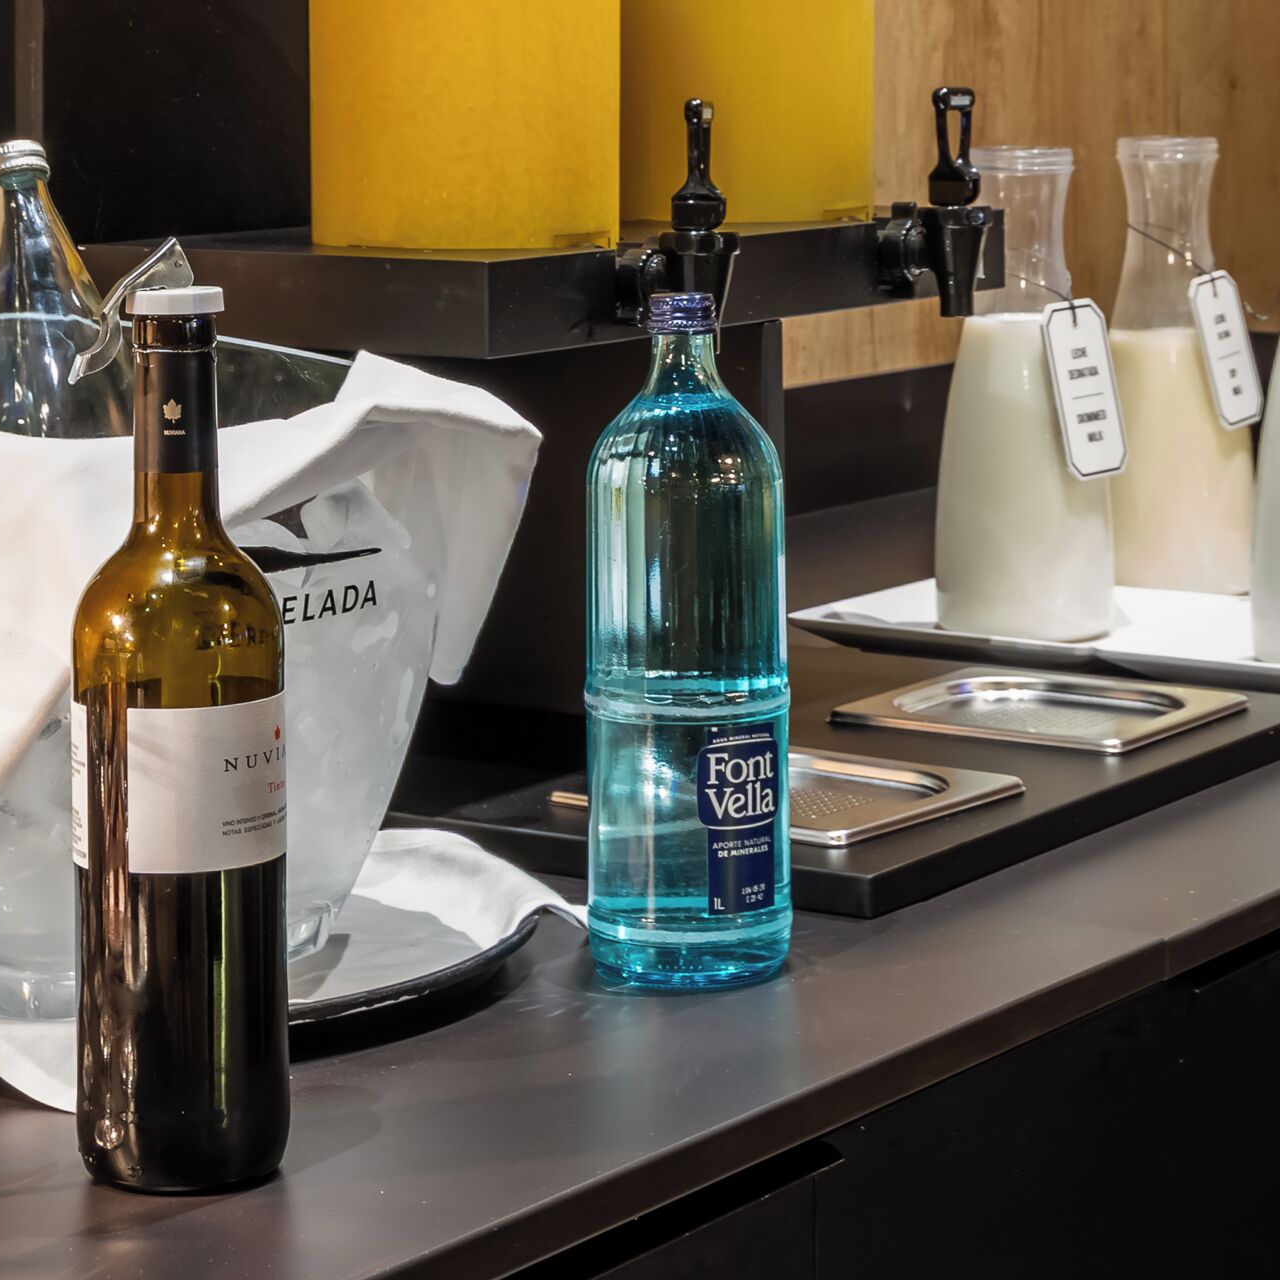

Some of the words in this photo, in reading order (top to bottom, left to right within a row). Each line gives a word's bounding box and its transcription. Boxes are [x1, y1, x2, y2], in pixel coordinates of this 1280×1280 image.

[706, 751, 774, 785] Font
[704, 781, 775, 820] Vella
[712, 840, 742, 850] APORTE
[744, 836, 772, 847] NATURAL
[717, 850, 728, 858] DE
[730, 844, 769, 857] MINERALES
[713, 897, 726, 910] 1L
